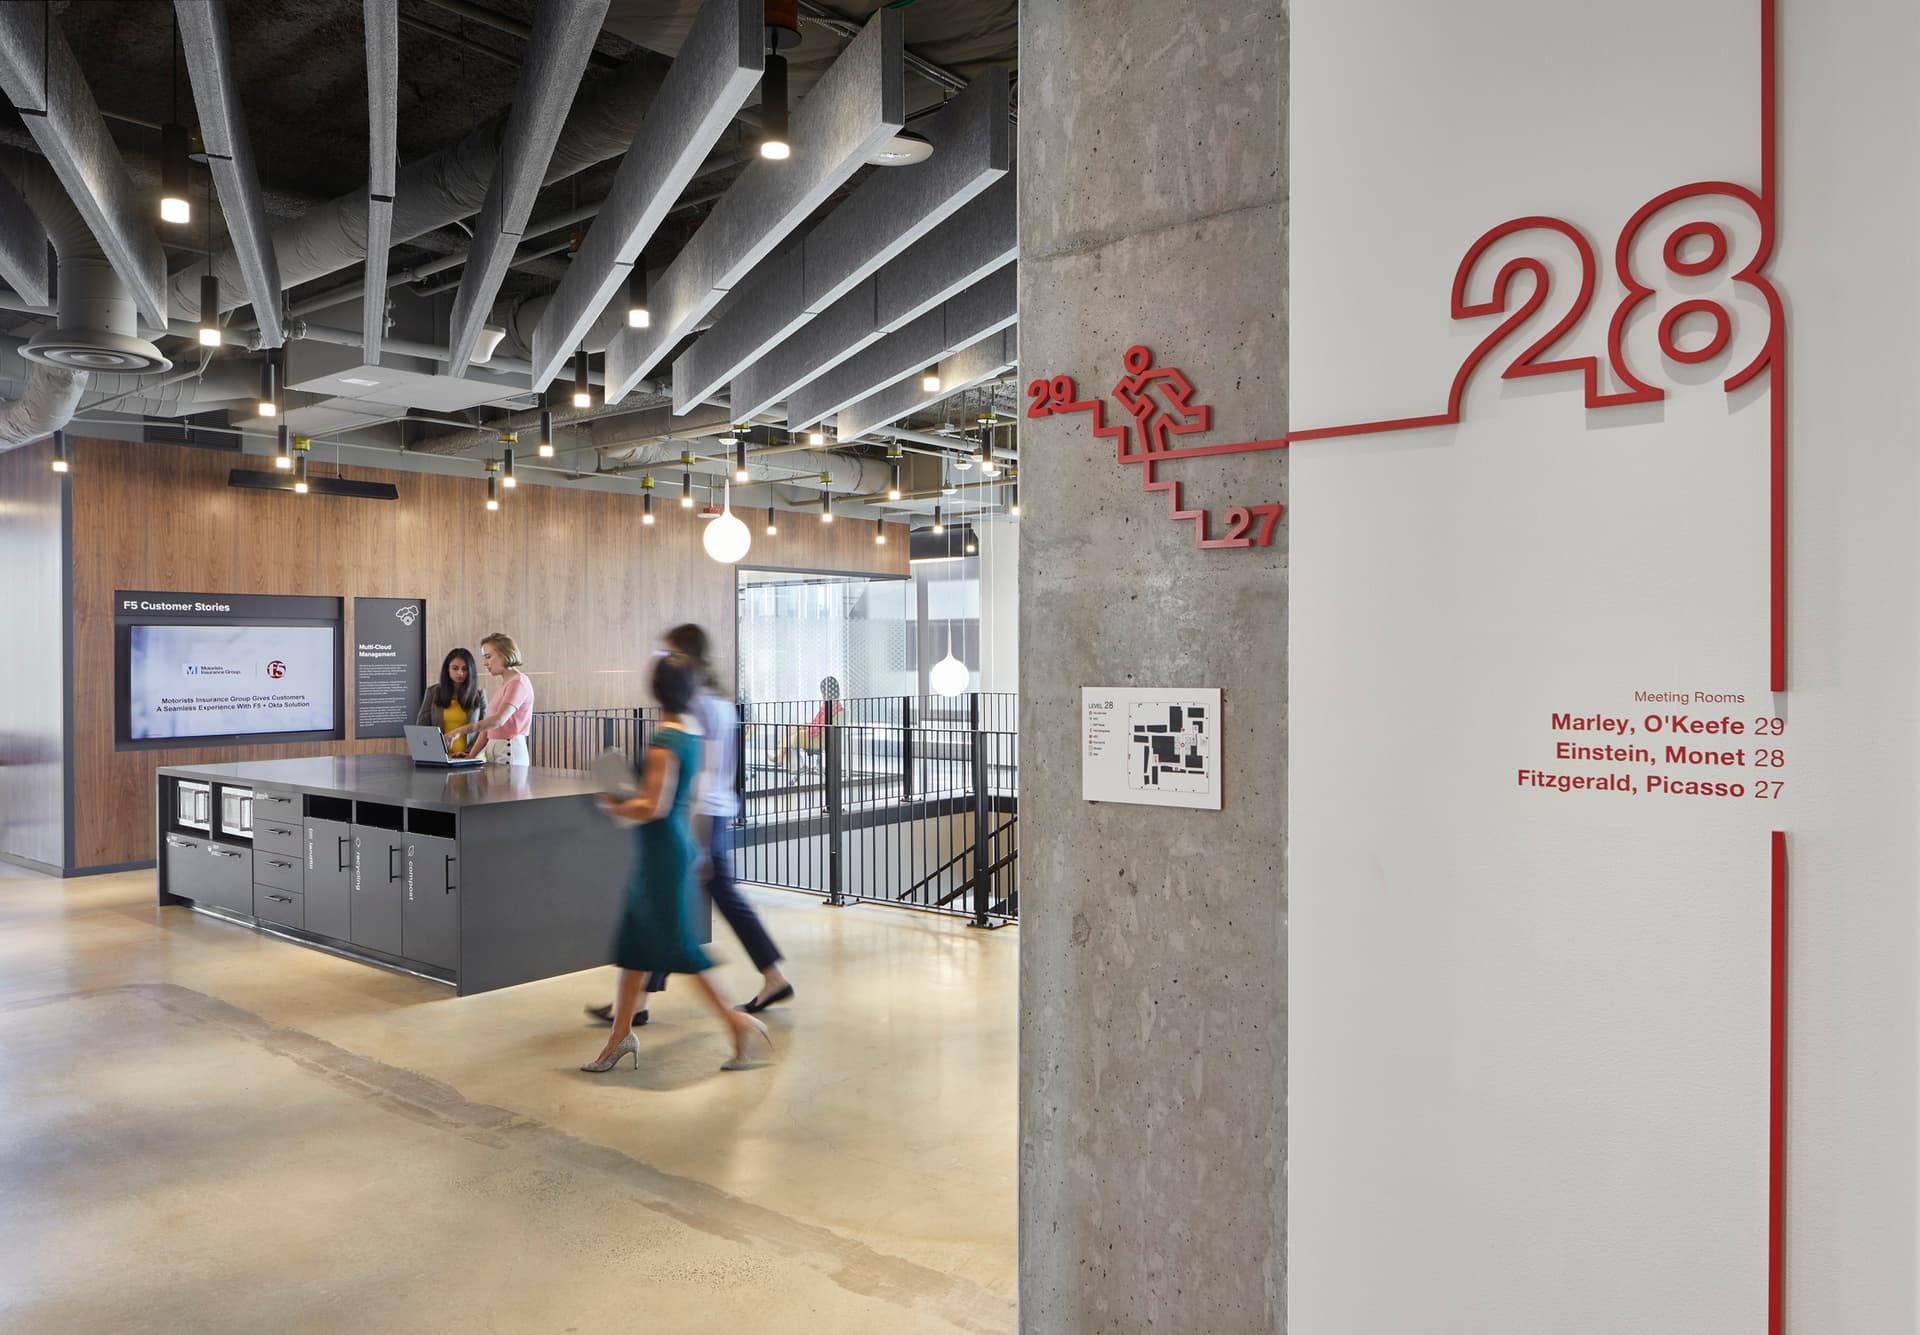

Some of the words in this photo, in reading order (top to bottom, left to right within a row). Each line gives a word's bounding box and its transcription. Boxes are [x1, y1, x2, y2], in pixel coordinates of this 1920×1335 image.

[1451, 181, 1785, 409] 28
[1027, 375, 1075, 418] 29
[1223, 504, 1282, 549] 27
[123, 600, 138, 610] F5
[141, 601, 192, 612] Customer
[195, 602, 231, 613] Stories
[163, 704, 197, 712] Seamless
[198, 703, 236, 711] Experience
[230, 695, 251, 703] Group
[1104, 701, 1114, 709] 28
[1634, 691, 1689, 705] Meeting
[1694, 691, 1745, 704] Rooms
[1551, 713, 1636, 735] Marley,
[1644, 714, 1745, 735] O'Keefe
[1754, 717, 1785, 736] 29
[1556, 742, 1656, 766] Einstein,
[1665, 745, 1745, 766] Monet
[1754, 748, 1785, 768] 28
[1517, 769, 1638, 795] Fitzgerald,
[1646, 775, 1745, 797] Picasso
[1754, 780, 1785, 799] 27
